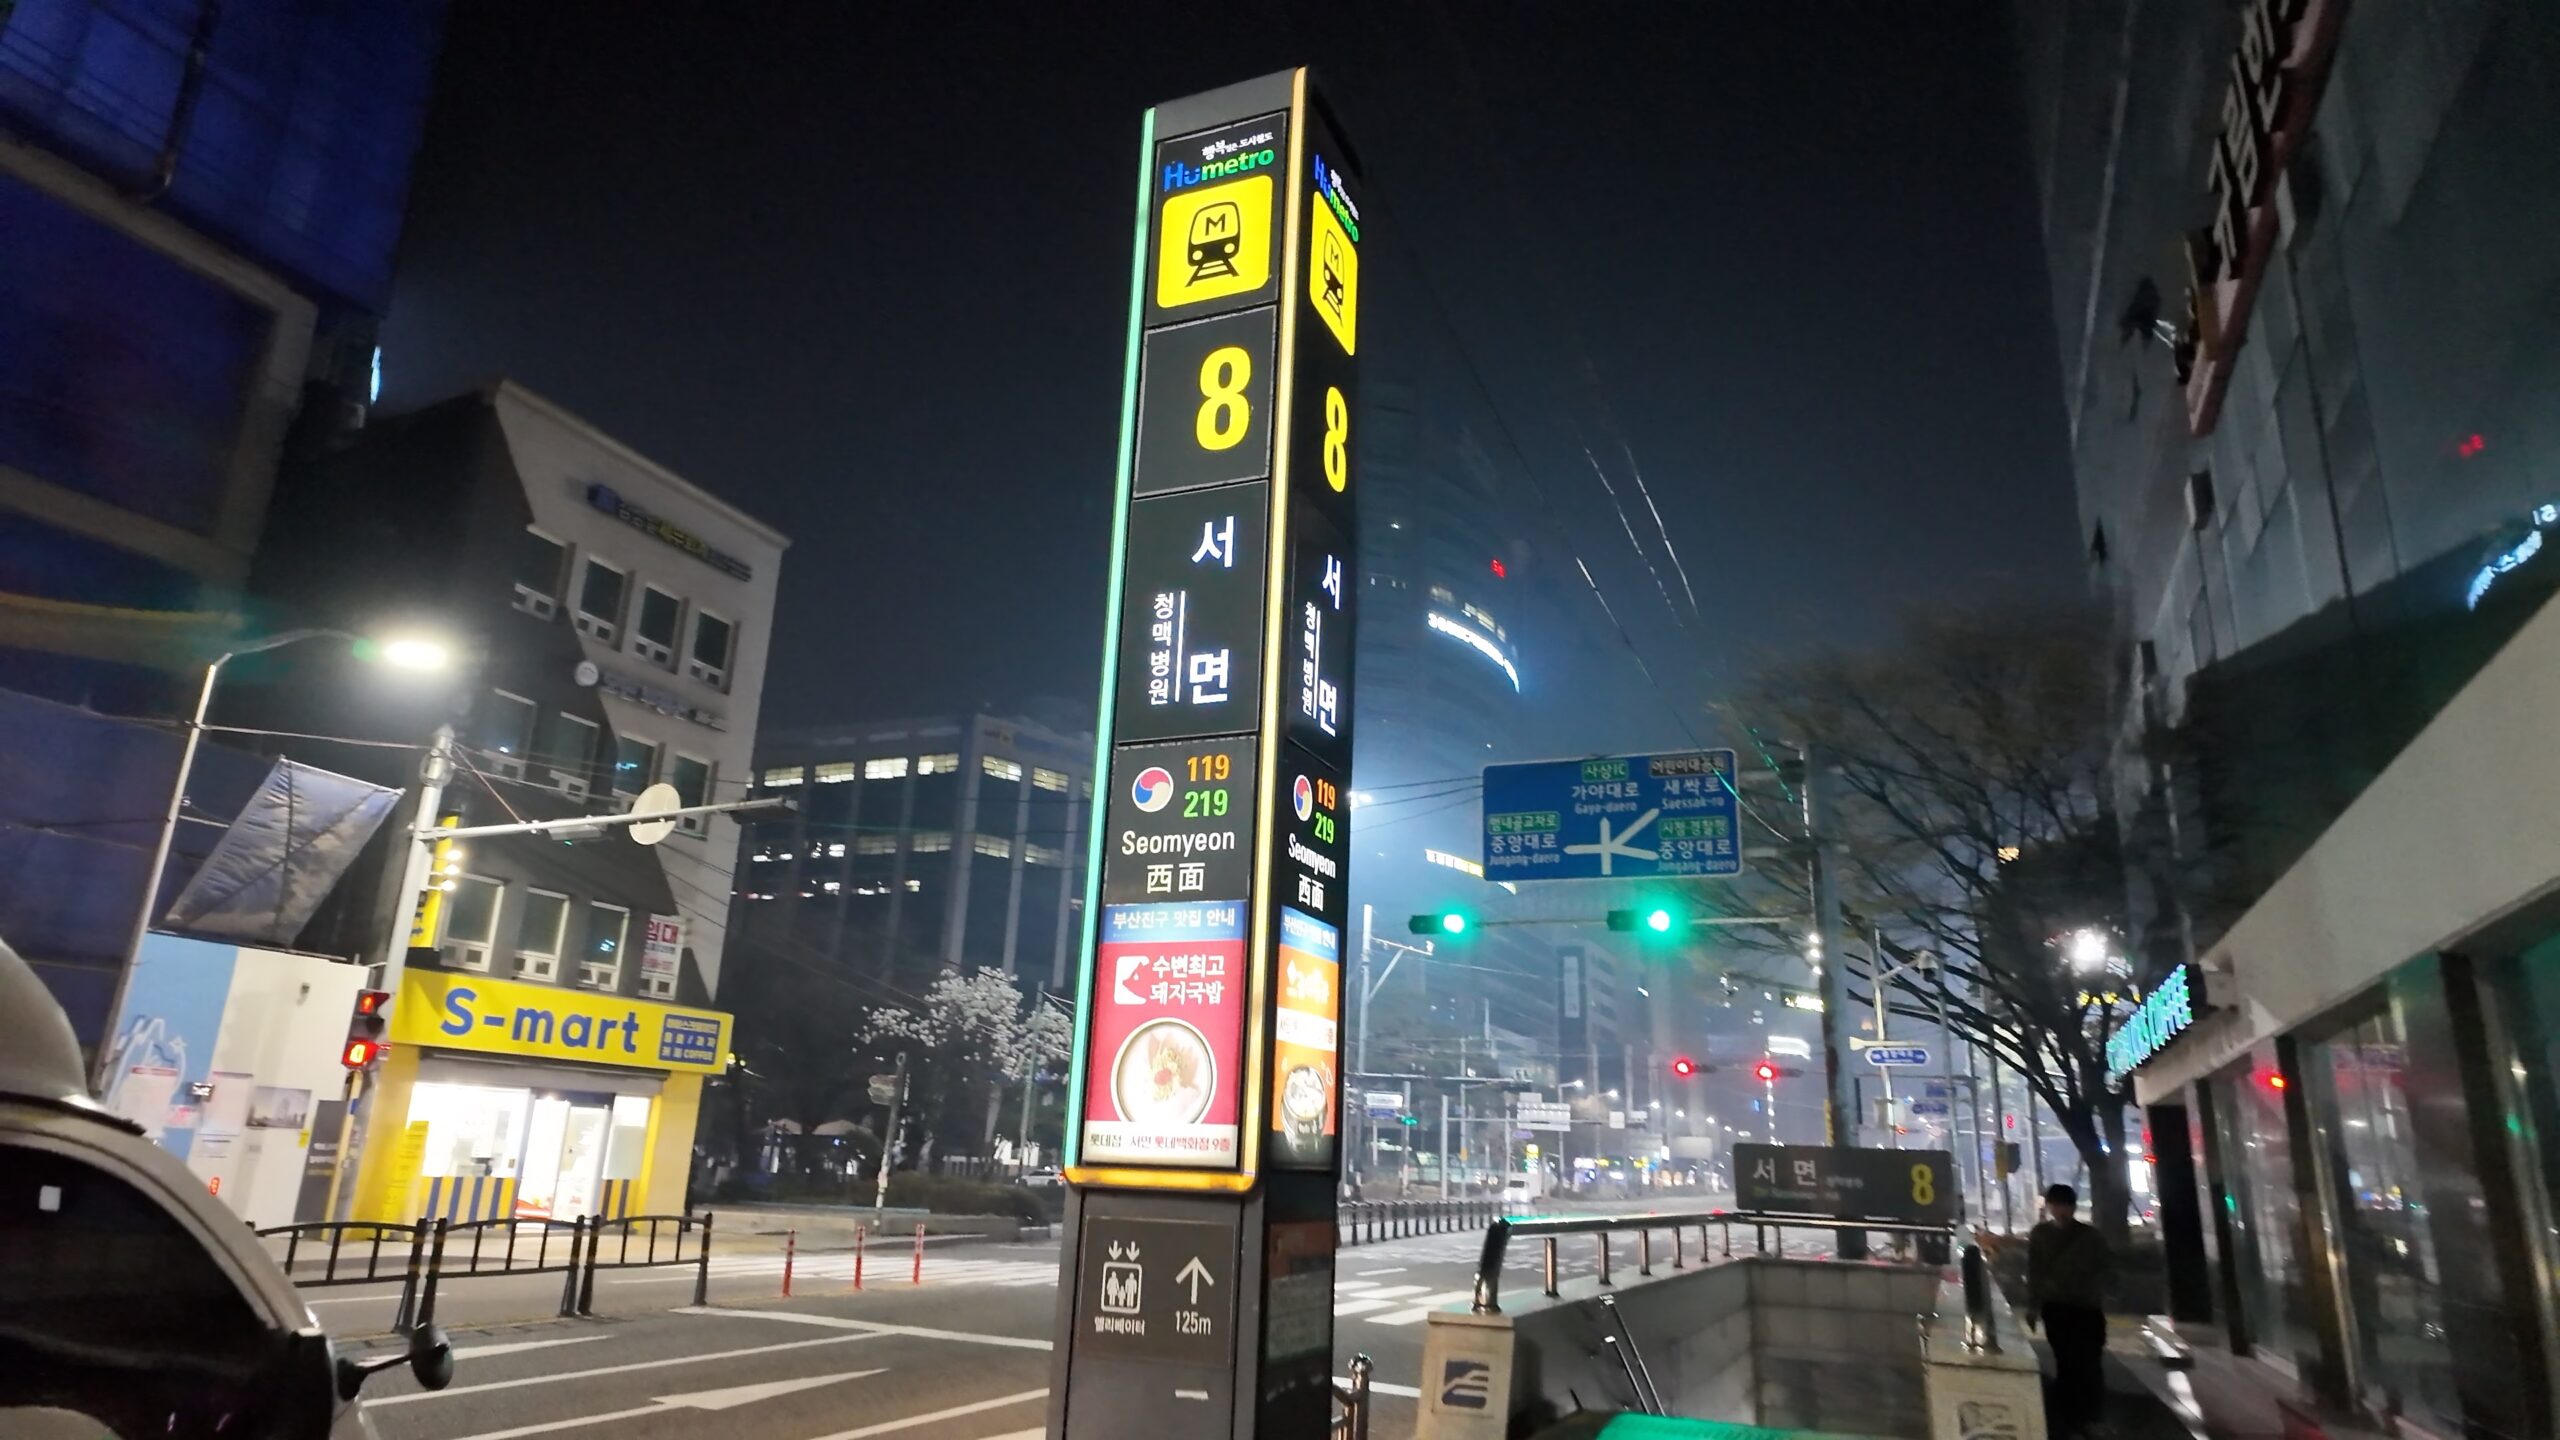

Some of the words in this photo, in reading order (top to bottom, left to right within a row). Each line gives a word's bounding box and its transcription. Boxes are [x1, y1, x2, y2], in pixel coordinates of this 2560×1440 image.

[1163, 149, 1275, 191] Humetro
[1314, 154, 1359, 242] Humetro
[1205, 213, 1226, 236] M
[1196, 346, 1251, 450] 8
[1323, 386, 1348, 493] 8
[1187, 754, 1230, 782] 119
[1183, 789, 1229, 818] 219
[1316, 778, 1336, 811] 119
[1571, 782, 1640, 800] 가야대로
[1314, 812, 1335, 845] 219
[1122, 830, 1236, 857] Seomyeon
[1288, 833, 1337, 879] Seomyeon
[1490, 833, 1558, 854] 중앙대로
[1658, 839, 1733, 860] 중앙대로
[1147, 862, 1206, 894] 西面
[1113, 912, 1169, 930] 부산진구
[1174, 909, 1201, 927] 맛집
[1206, 907, 1236, 927] 안내
[1152, 954, 1225, 979] 수변최고
[1150, 980, 1225, 1006] 돼지국밥
[441, 988, 639, 1053] S-mart
[1910, 1163, 1935, 1206] 8
[1094, 1316, 1145, 1336] 엘리베이터
[1175, 1310, 1211, 1335] 125m
